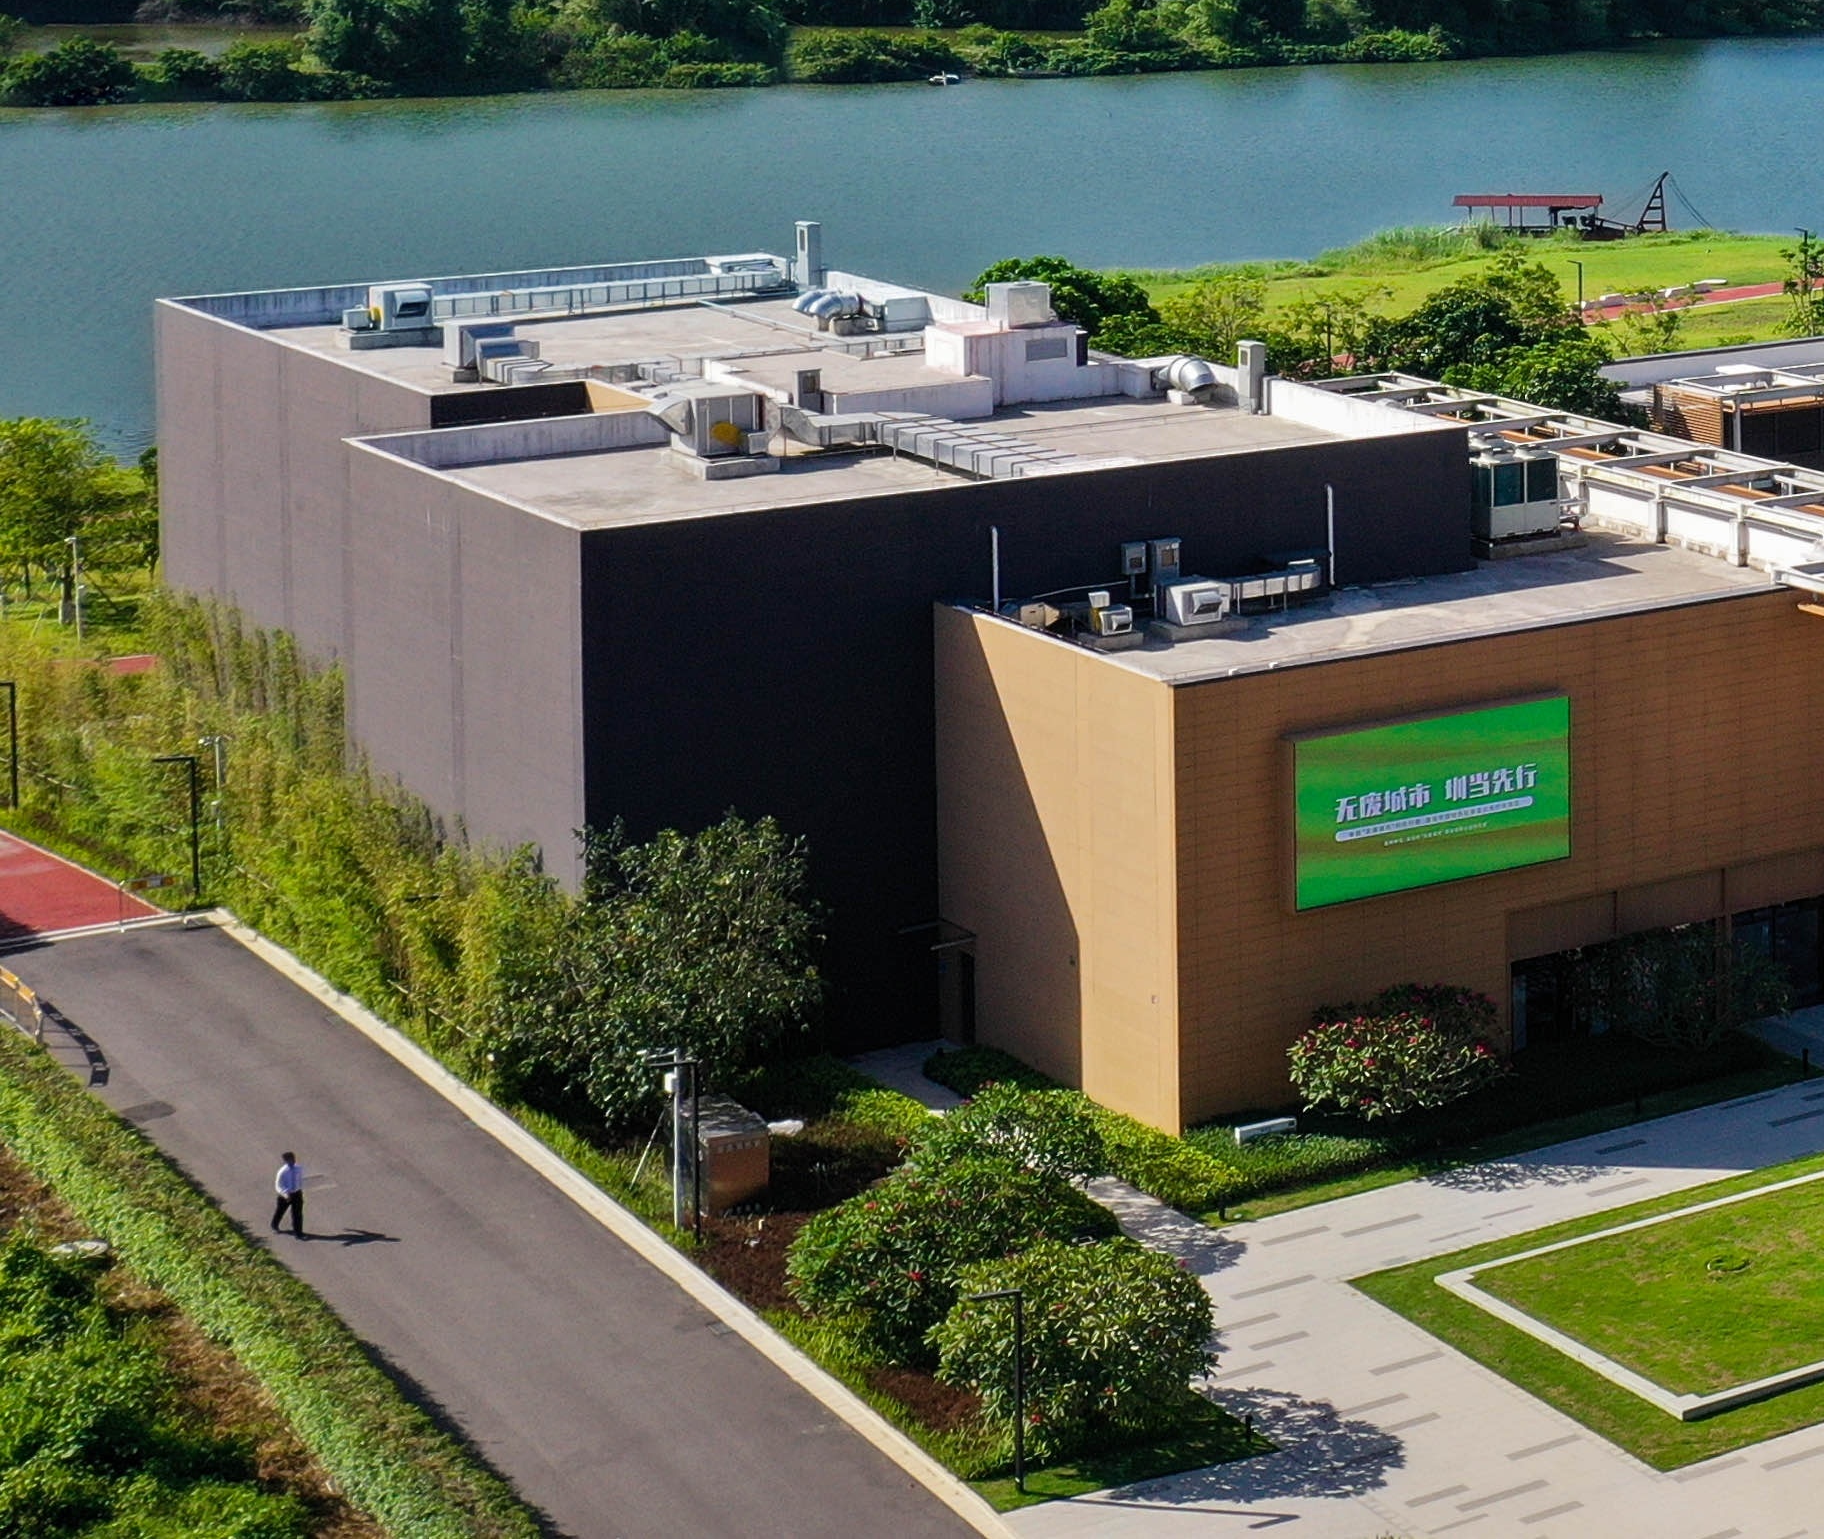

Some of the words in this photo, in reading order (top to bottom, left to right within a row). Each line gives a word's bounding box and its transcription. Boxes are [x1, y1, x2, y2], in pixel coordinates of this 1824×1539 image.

[1334, 783, 1432, 823] 无废城市
[1444, 763, 1537, 802] 圳当先行
